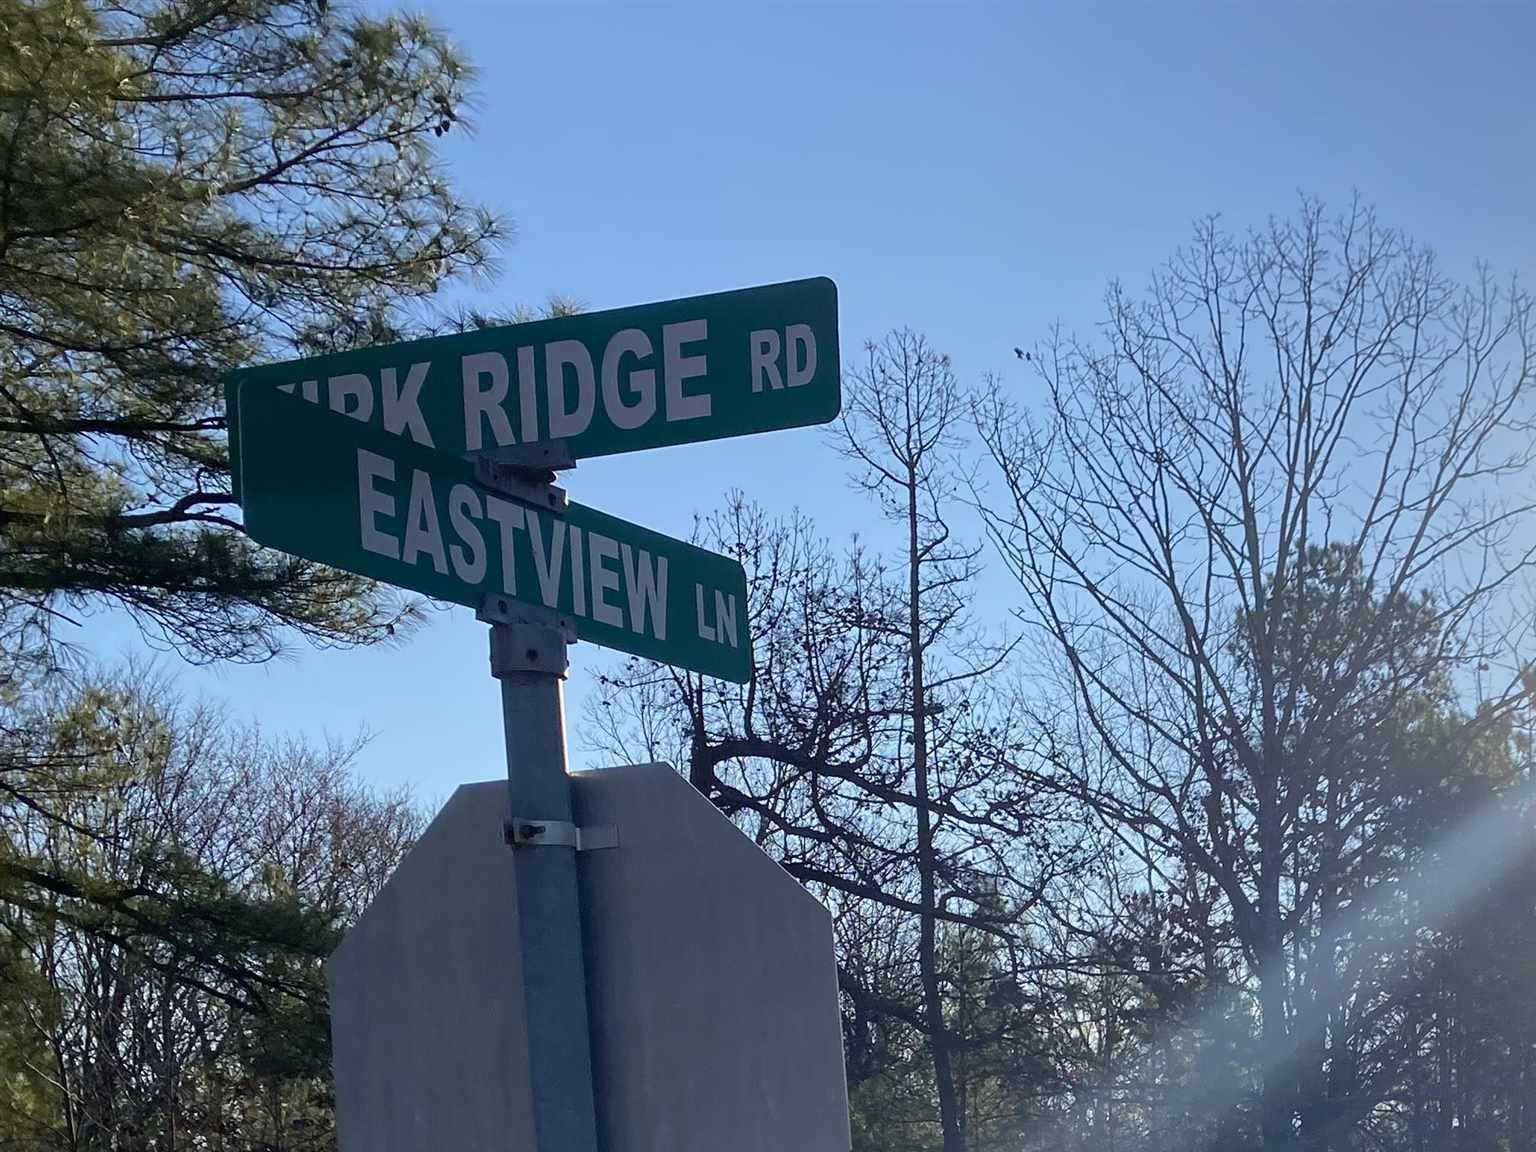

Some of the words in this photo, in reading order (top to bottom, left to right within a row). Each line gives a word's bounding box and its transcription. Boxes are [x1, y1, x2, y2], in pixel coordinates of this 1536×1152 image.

[462, 319, 712, 451] RIDGE
[750, 323, 817, 393] RD
[357, 448, 668, 641] EASTVIEW
[695, 583, 738, 649] LN
